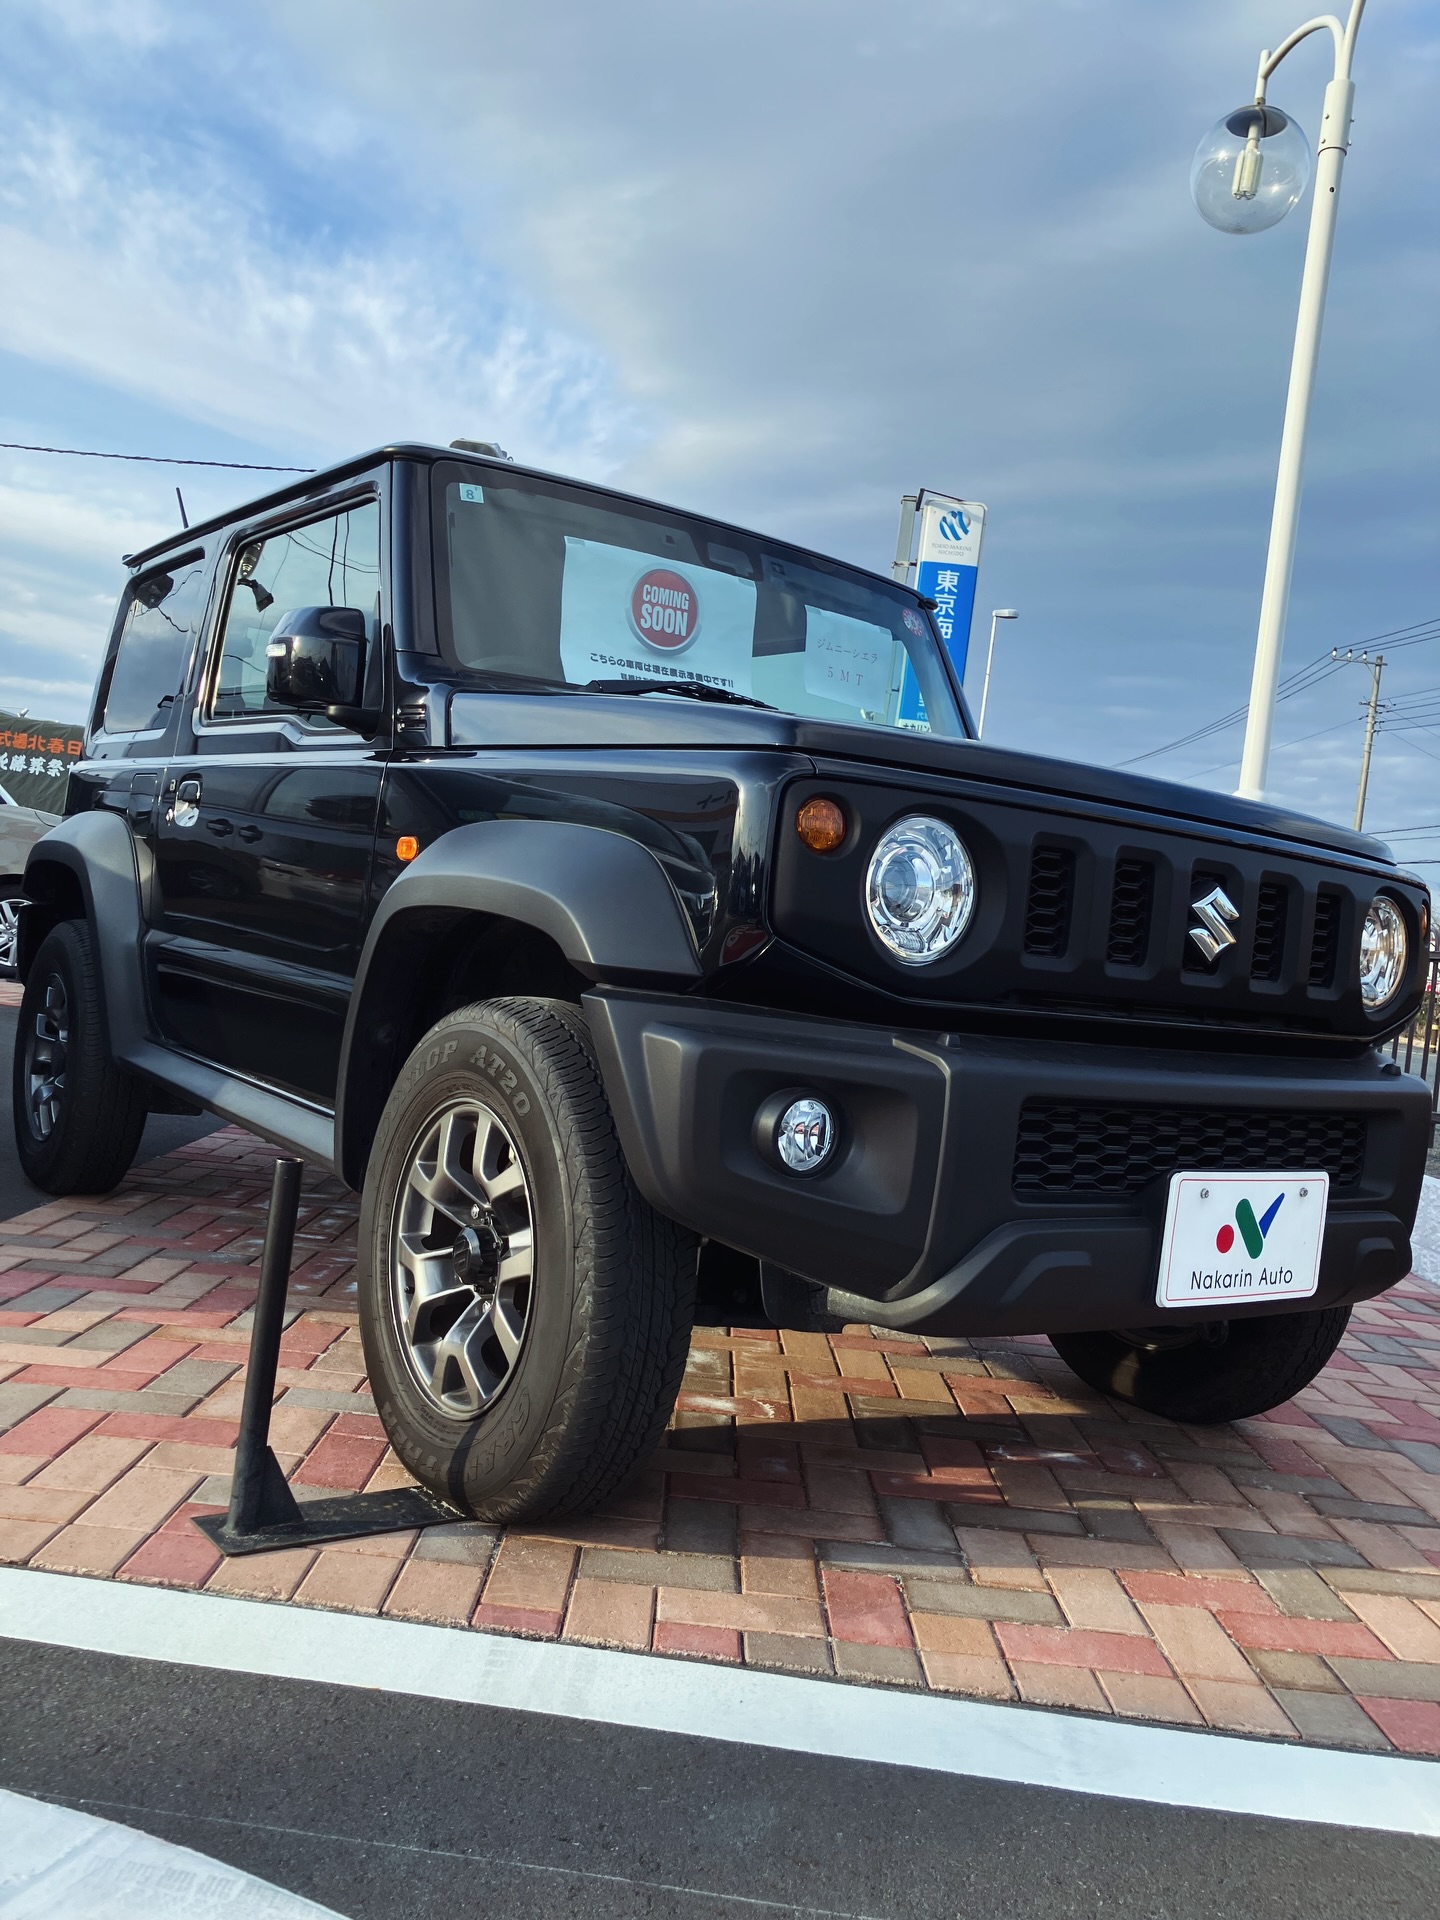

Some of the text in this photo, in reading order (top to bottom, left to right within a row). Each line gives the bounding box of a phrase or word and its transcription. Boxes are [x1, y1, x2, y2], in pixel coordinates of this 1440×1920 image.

[938, 549, 965, 557] NICHIDO
[950, 544, 972, 552] MARINE
[642, 584, 690, 611] COMING
[640, 603, 688, 637] SOON
[817, 638, 878, 664] ジムニーシエラ
[469, 1044, 532, 1117] AT20
[1190, 1266, 1293, 1291] Nakarin Auto
